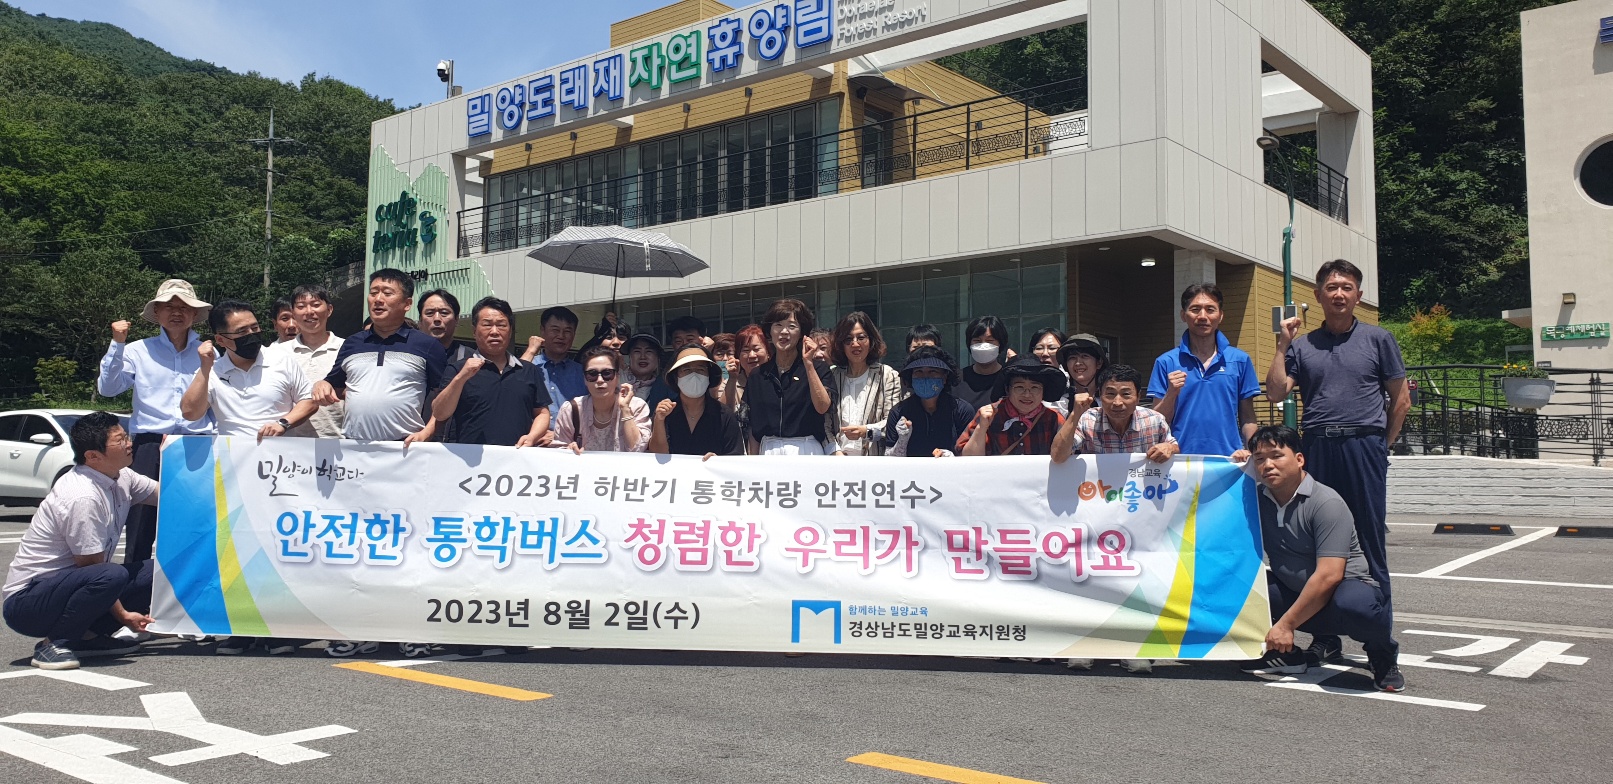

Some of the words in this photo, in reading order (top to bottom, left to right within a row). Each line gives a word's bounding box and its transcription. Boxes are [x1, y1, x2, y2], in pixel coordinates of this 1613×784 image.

[837, 17, 879, 39] Forest
[880, 3, 928, 27] Resort
[1128, 468, 1161, 478] 경남교육
[458, 473, 580, 500] <2023년
[593, 475, 677, 504] 하반기
[690, 480, 802, 509] 통학차량
[814, 479, 943, 509] 안전연수>
[1078, 475, 1179, 513] 아이좋아
[276, 510, 407, 561] 안전한
[425, 515, 606, 564] 통학버스
[624, 517, 762, 567] 청렴한
[784, 524, 920, 573] 우리가
[945, 526, 1137, 577] 만들어요
[426, 598, 530, 628] 2023년
[543, 599, 591, 630] 8월
[604, 599, 701, 631] 2일(수)
[848, 604, 887, 616] 함께하는
[890, 605, 928, 617] 밀양교육
[848, 621, 1027, 641] 경상남도밀양교육지원청
